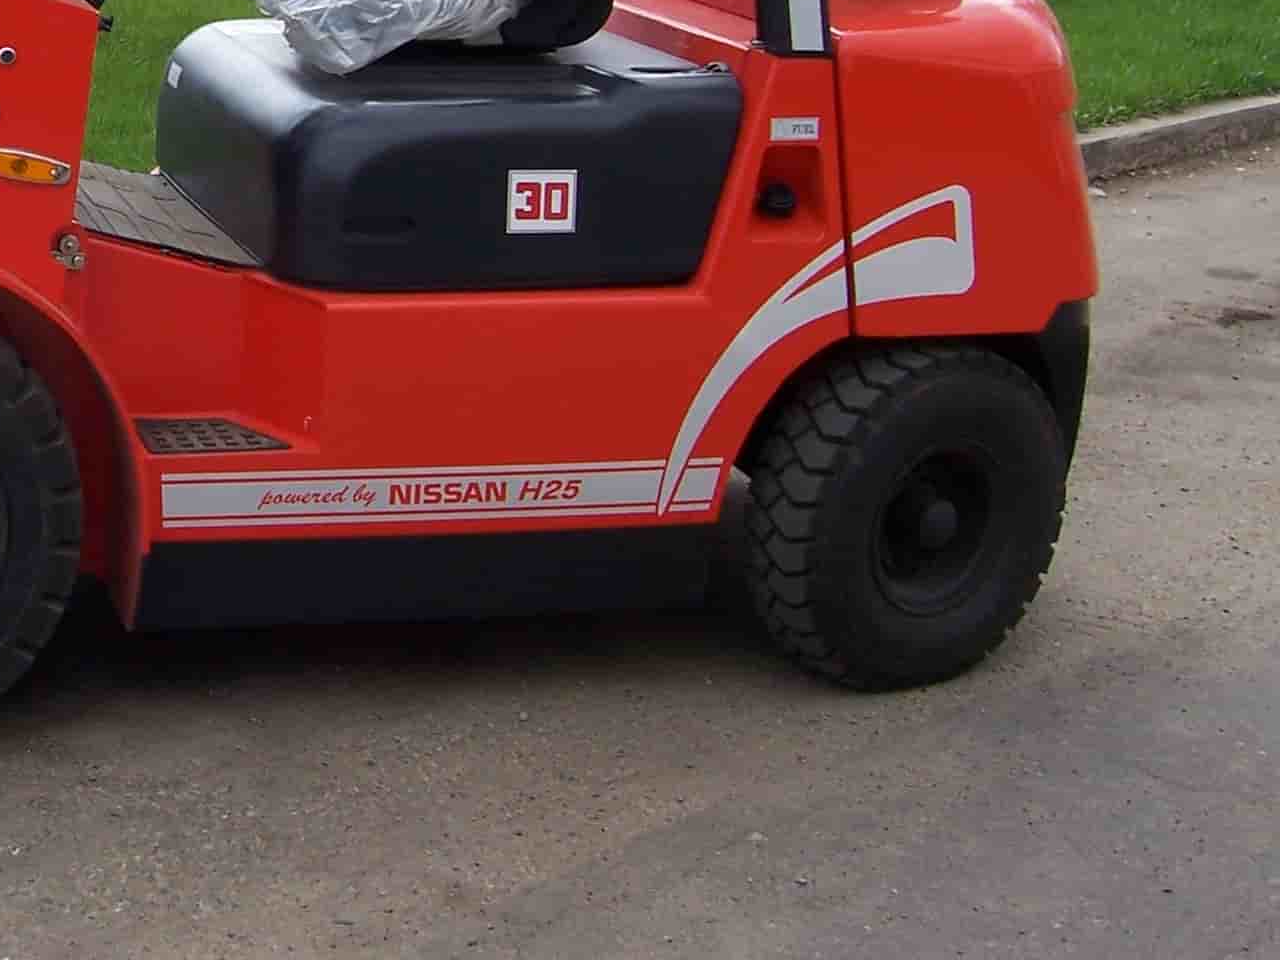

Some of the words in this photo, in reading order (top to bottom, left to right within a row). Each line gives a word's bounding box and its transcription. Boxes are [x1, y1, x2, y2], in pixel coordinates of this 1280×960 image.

[514, 181, 569, 220] 30
[256, 485, 350, 511] powered
[351, 483, 377, 507] by
[388, 481, 507, 506] NISSAN
[518, 480, 583, 503] H25
